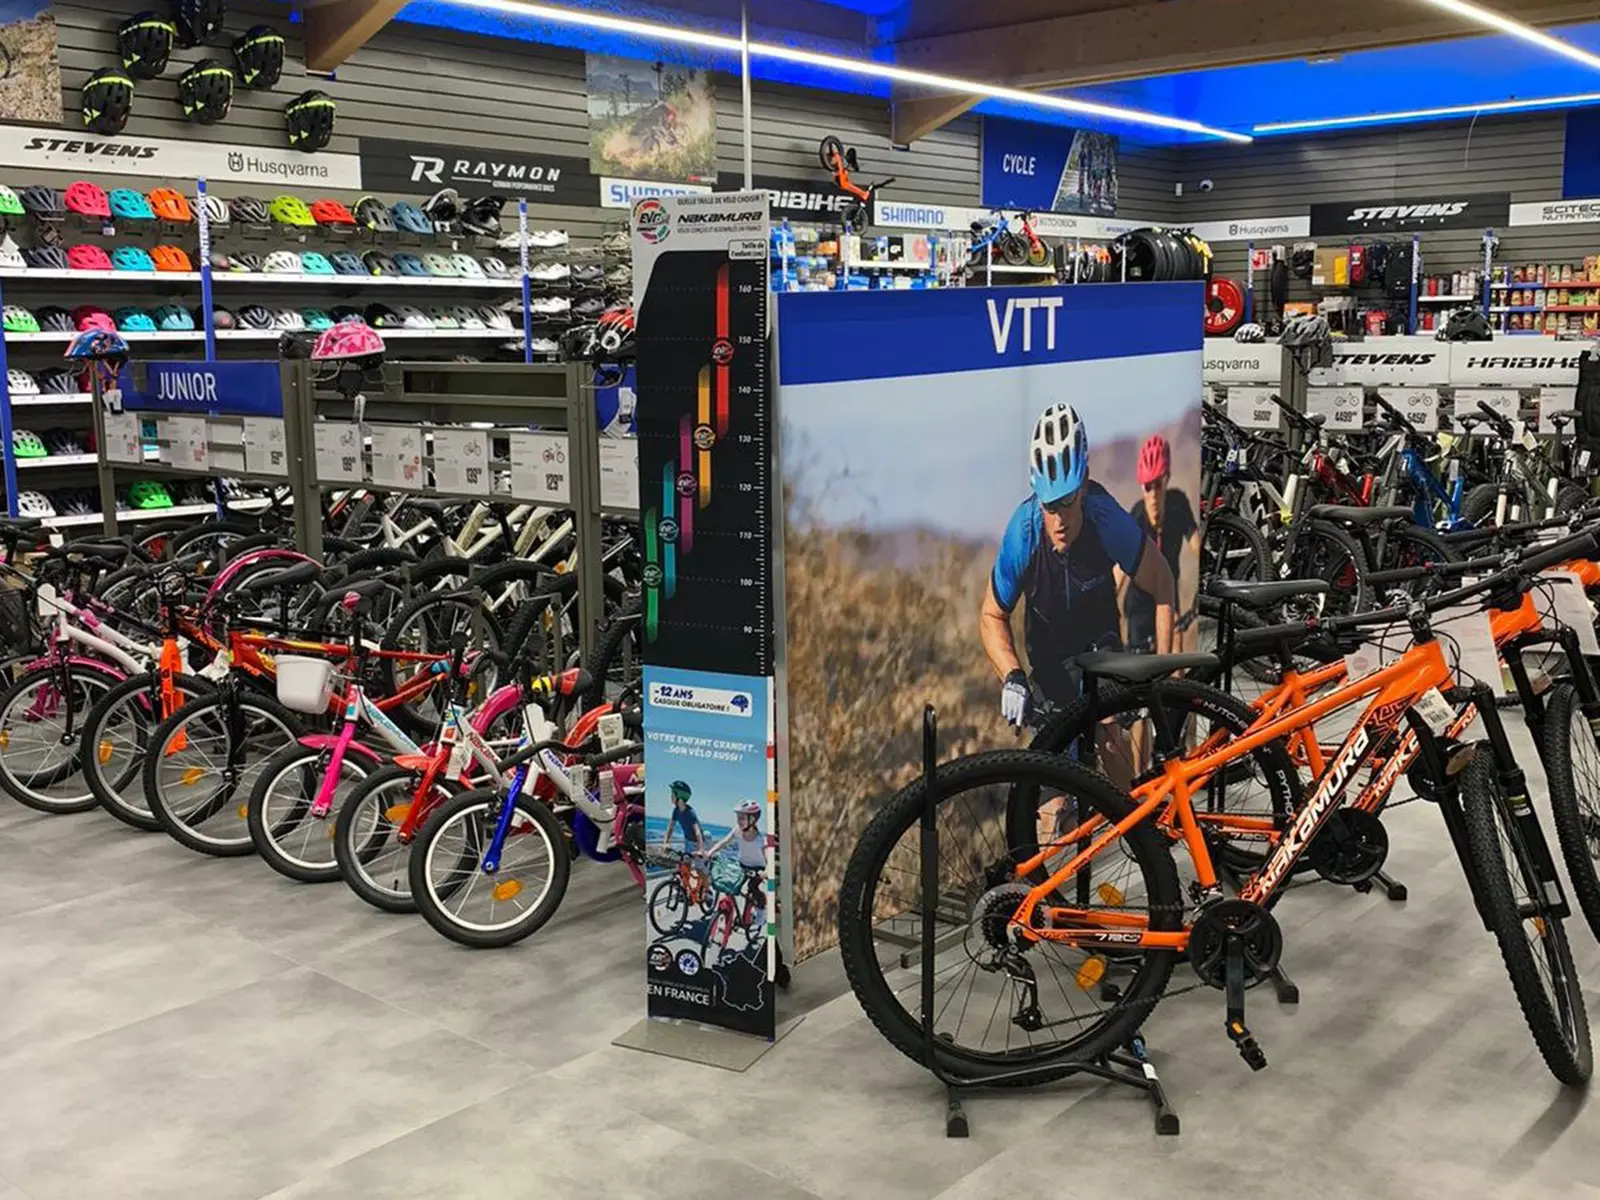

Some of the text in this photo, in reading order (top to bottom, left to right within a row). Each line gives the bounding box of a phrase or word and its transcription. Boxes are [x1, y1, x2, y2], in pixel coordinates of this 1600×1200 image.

[24, 137, 159, 159] STEVENS
[247, 157, 329, 178] Husqvarna
[453, 159, 561, 182] RAYMON
[1002, 154, 1036, 176] CYCLE
[881, 206, 944, 225] SHIMANO
[1347, 202, 1469, 221] STEVENS
[1239, 223, 1290, 236] Husqvarna
[738, 285, 752, 293] 160
[986, 296, 1064, 354] VTT
[738, 336, 752, 344] 150
[1202, 358, 1260, 373] usqvarna
[157, 371, 218, 402] JUNIOR
[738, 386, 752, 394] 140
[738, 435, 752, 443] 130
[654, 686, 694, 700] -12 ANS
[653, 697, 681, 707] CASQUE
[681, 699, 726, 712] OBLIGATOIRE
[646, 731, 676, 743] VOTRE
[676, 734, 712, 747] ENFANT
[688, 746, 713, 758] VÉLO
[1258, 724, 1370, 896] NAKAMURA
[646, 983, 663, 997] EN
[664, 987, 711, 1006] FRANCE
